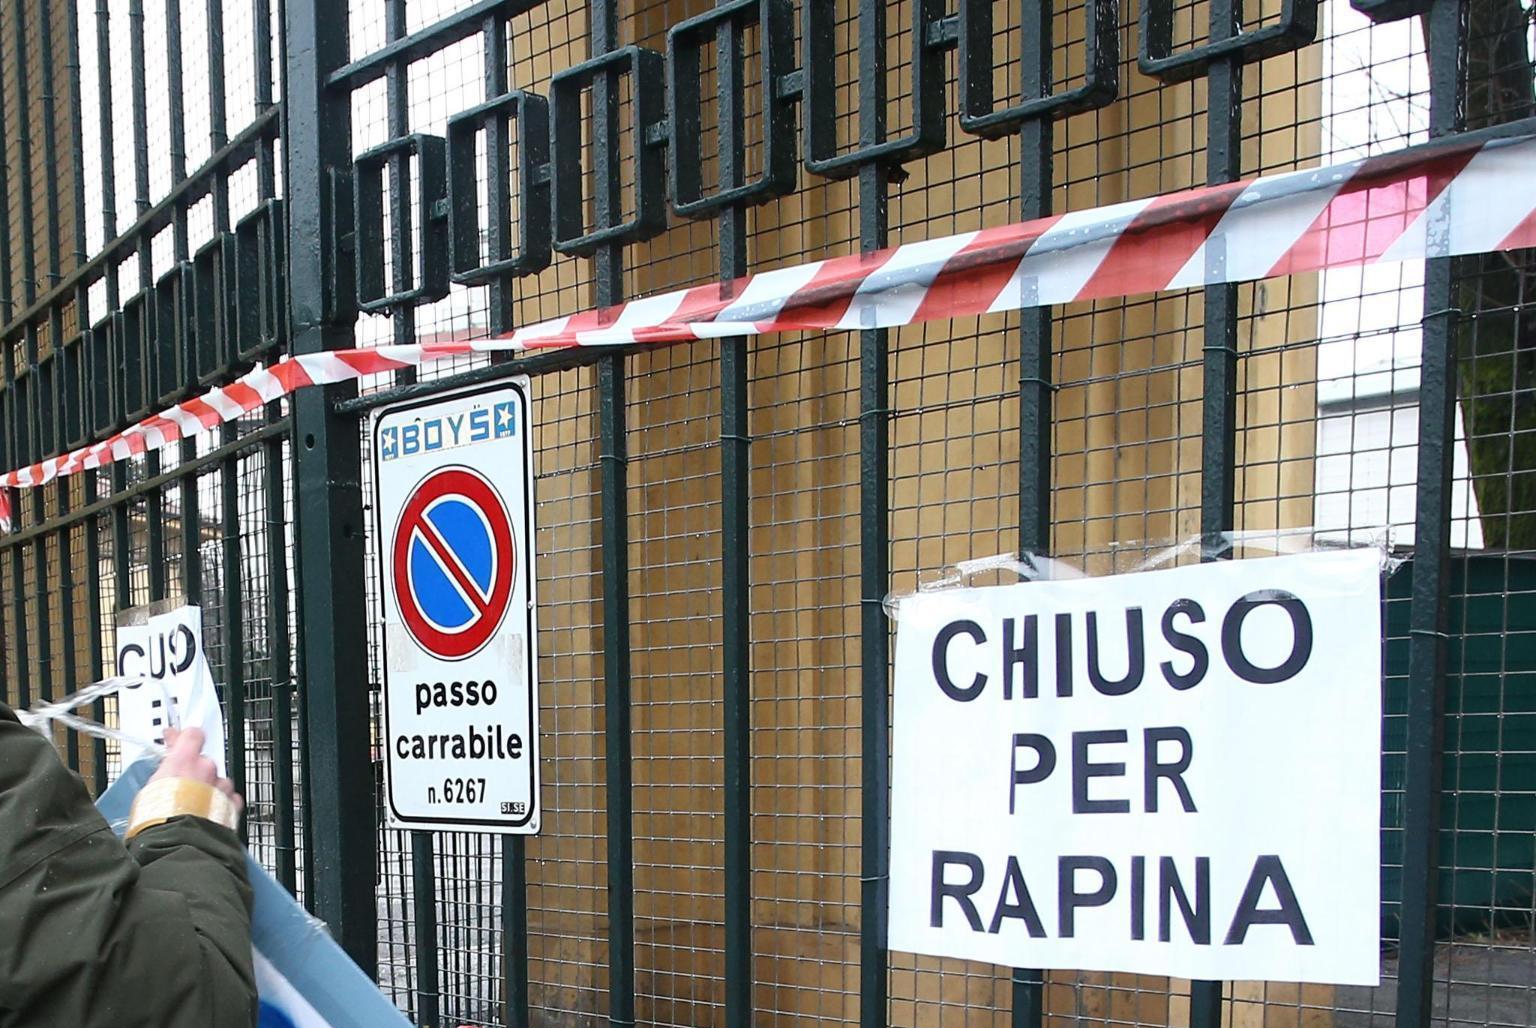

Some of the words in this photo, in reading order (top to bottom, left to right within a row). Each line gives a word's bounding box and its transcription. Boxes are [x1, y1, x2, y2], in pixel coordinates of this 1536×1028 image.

[402, 408, 490, 456] BOYS
[931, 588, 1313, 702] CHIUSO
[415, 679, 498, 715] passo
[396, 724, 523, 760] carrabile
[428, 777, 486, 804] n.6267
[1009, 725, 1198, 815] PER
[929, 849, 1315, 946] RAPINA
